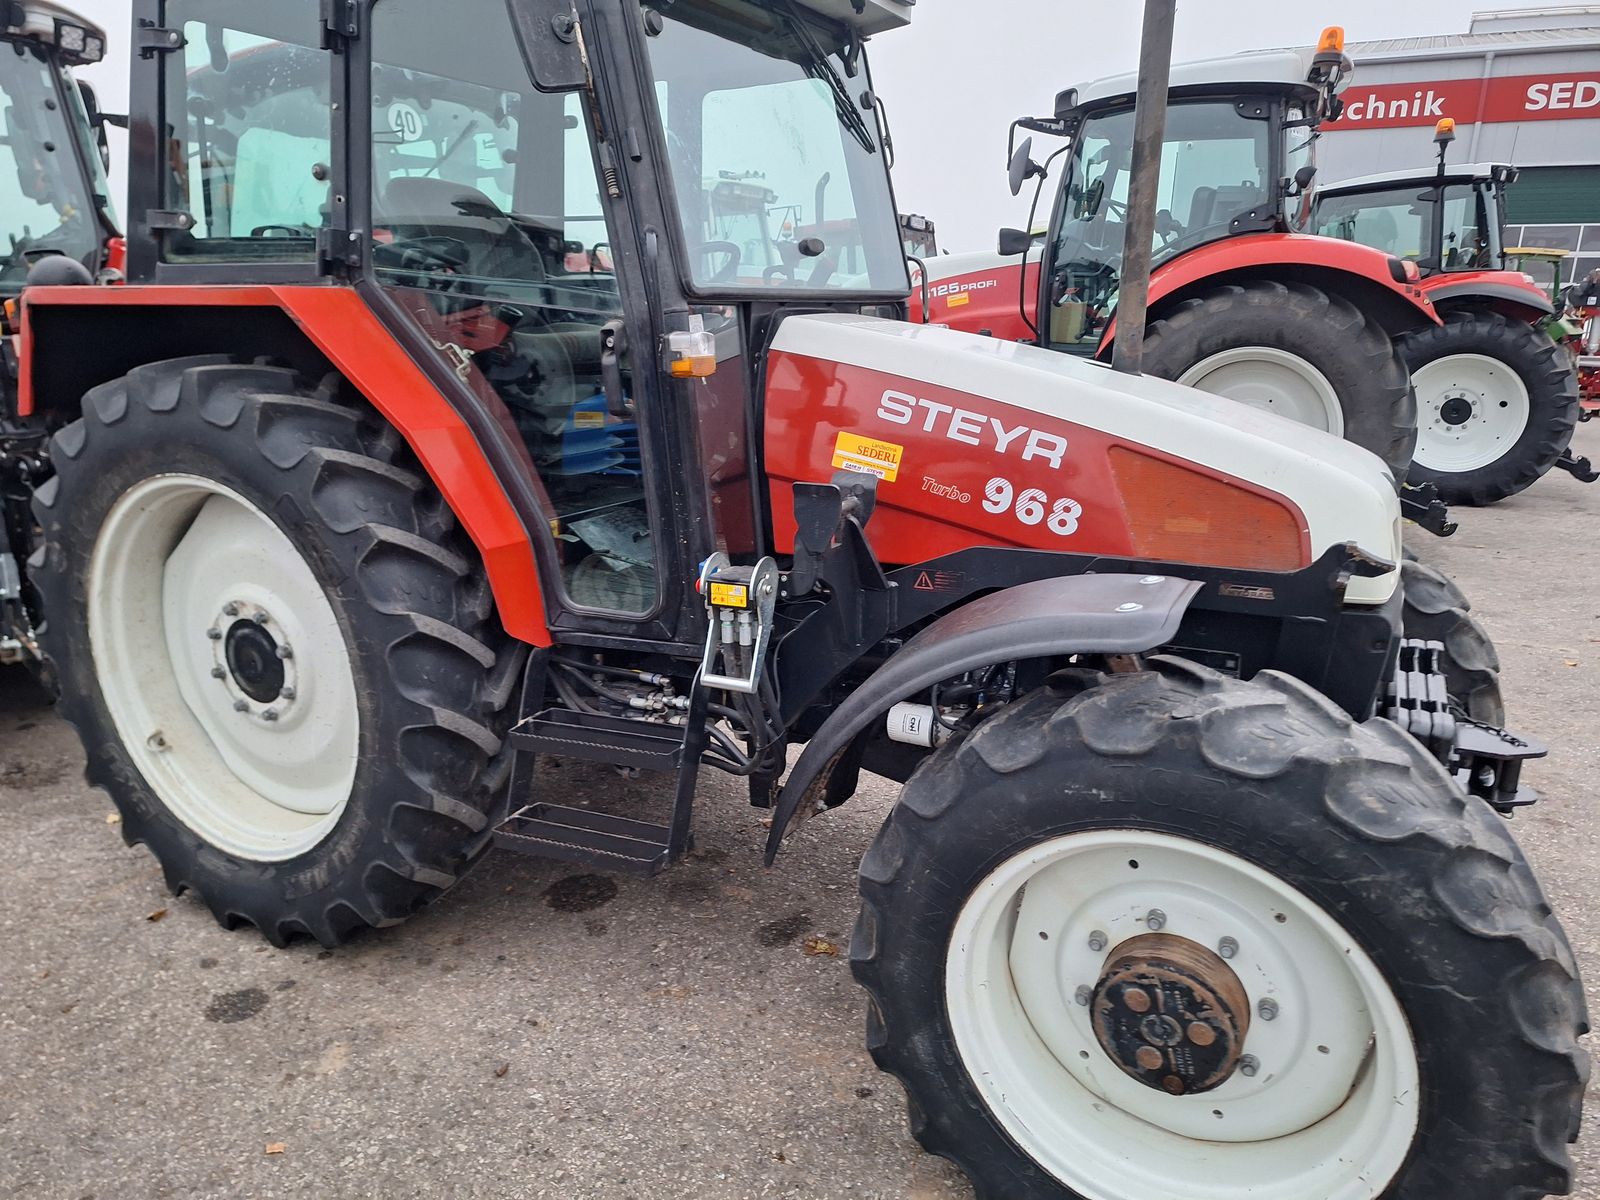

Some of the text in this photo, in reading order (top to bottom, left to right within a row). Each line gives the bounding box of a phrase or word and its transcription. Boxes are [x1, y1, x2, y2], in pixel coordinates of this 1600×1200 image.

[1524, 81, 1600, 111] SED
[395, 110, 416, 134] 40
[960, 279, 997, 292] PROFI
[876, 388, 1068, 470] STEYR
[856, 445, 898, 464] SEDERL
[921, 476, 1082, 536] Turbo 968
